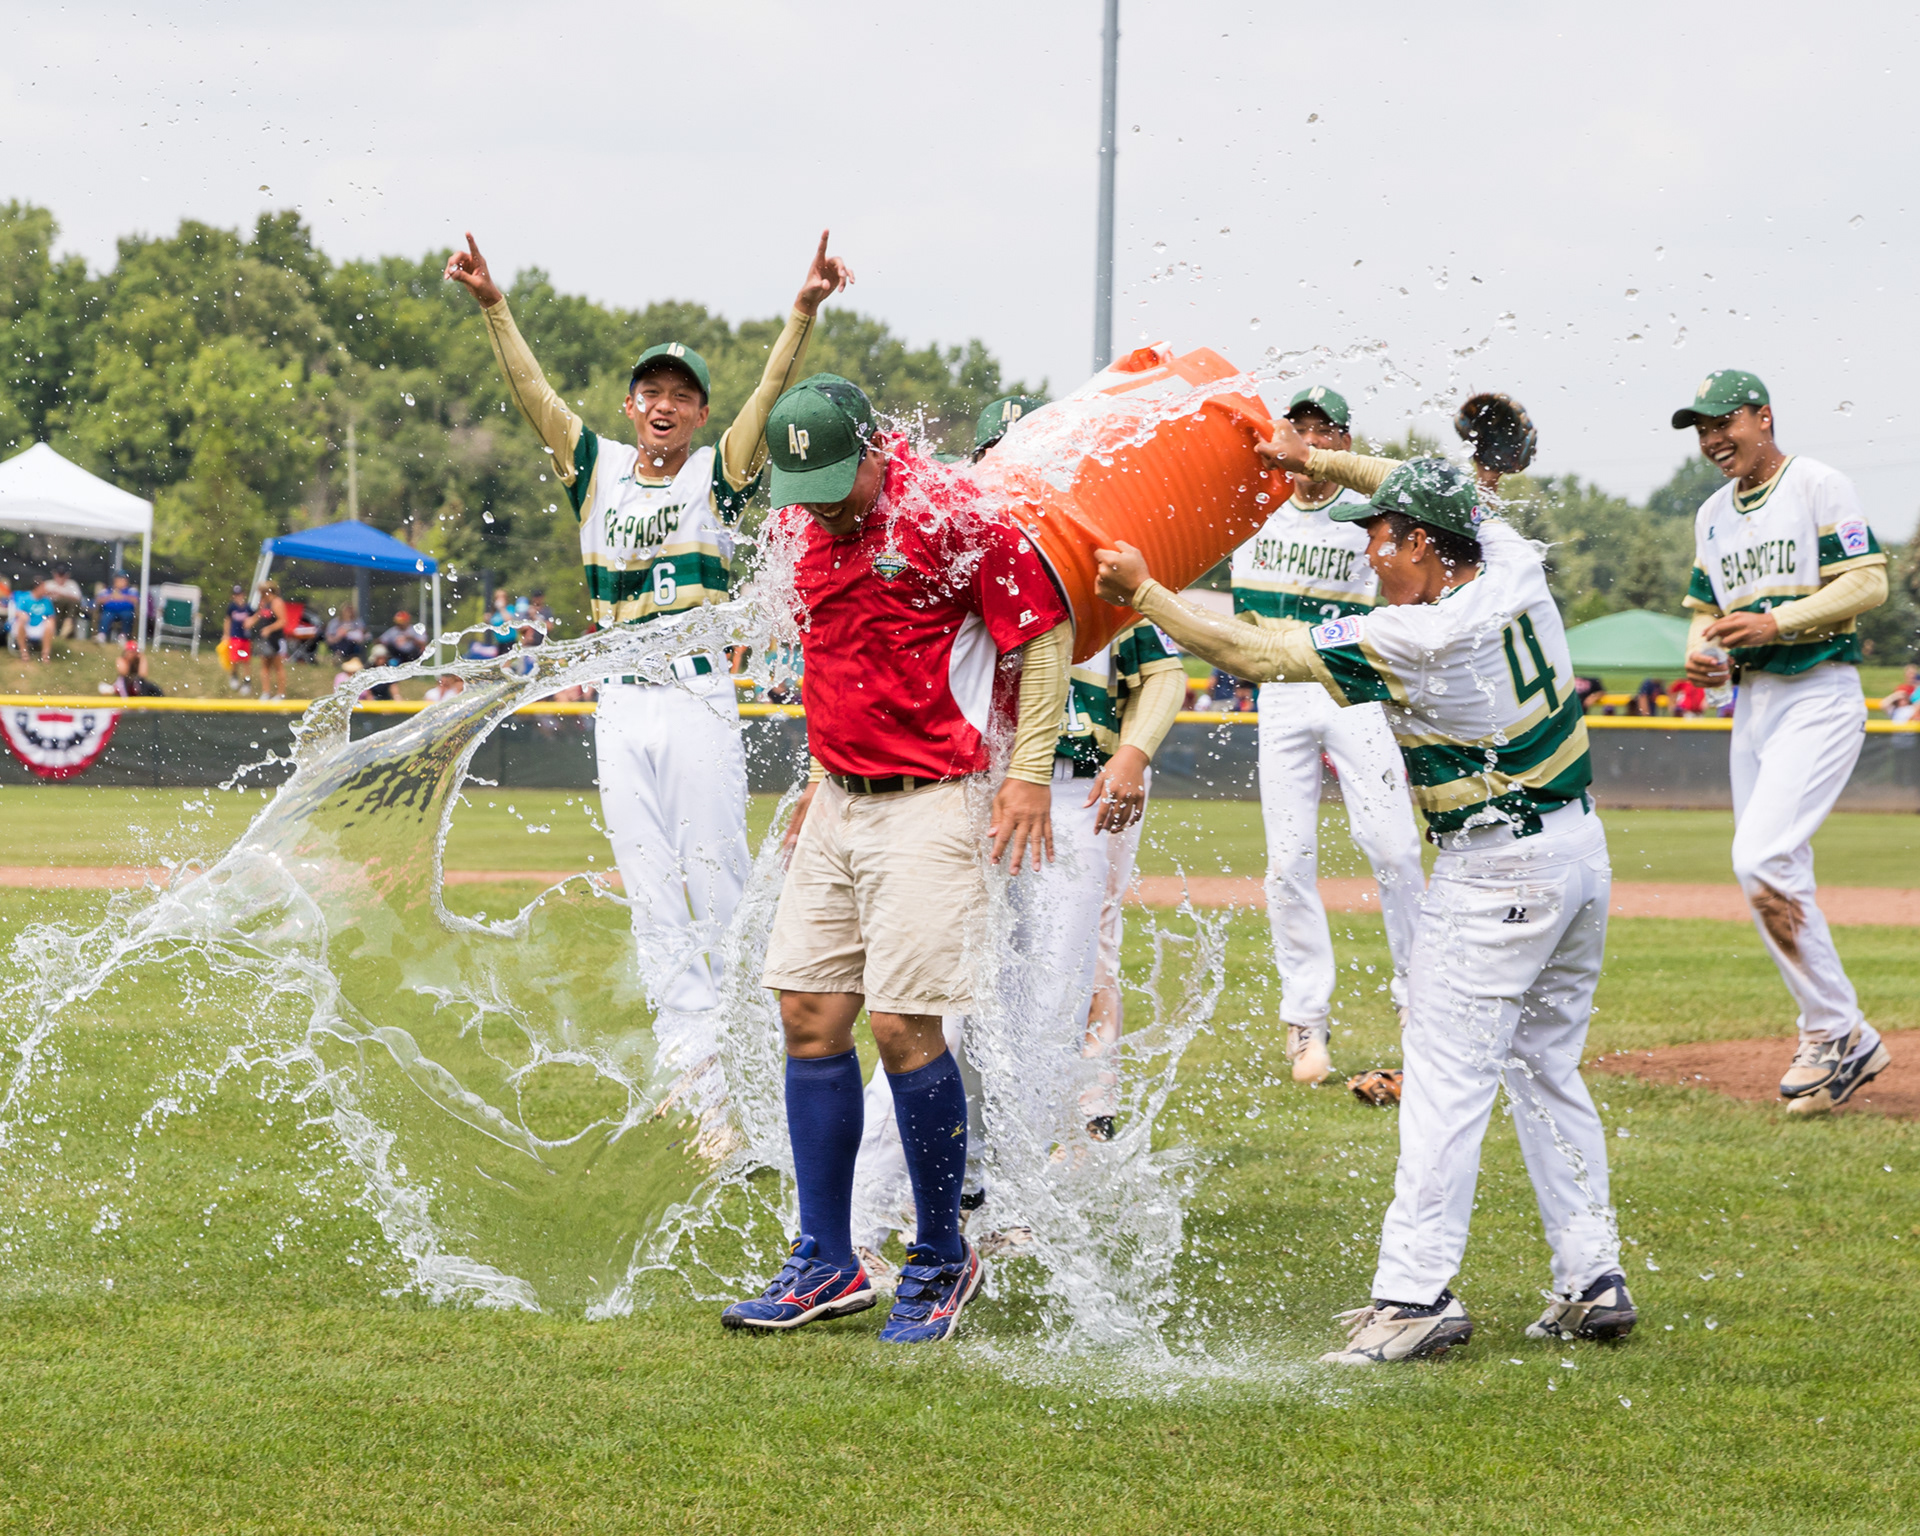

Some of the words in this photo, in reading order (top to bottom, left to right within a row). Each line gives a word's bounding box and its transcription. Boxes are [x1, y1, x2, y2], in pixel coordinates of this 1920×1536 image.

[1001, 400, 1022, 423] AP
[1252, 538, 1355, 581] ASIA-PACIFIC
[652, 562, 677, 606] 6
[1500, 609, 1563, 719] 4
